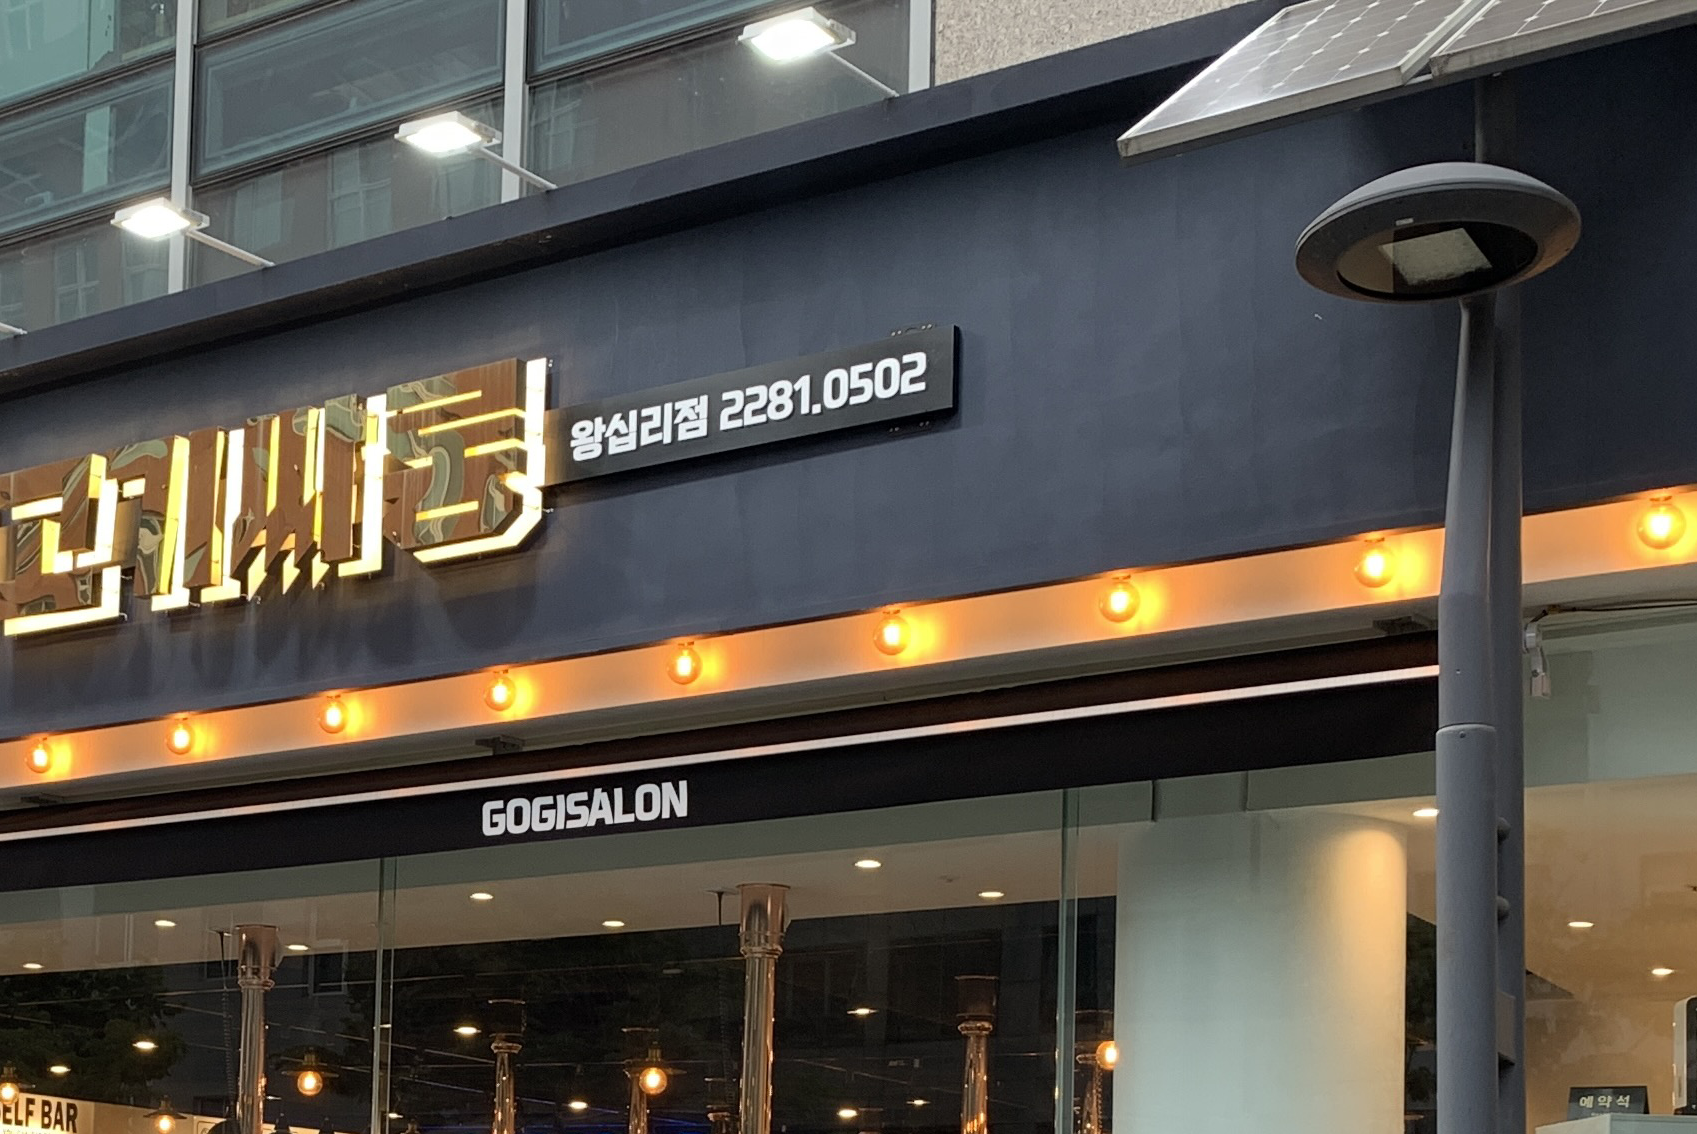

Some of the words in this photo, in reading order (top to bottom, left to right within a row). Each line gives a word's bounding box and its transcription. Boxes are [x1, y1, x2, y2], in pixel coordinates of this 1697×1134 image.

[569, 398, 708, 464] 왕십리점
[719, 351, 928, 432] 2281.0502
[482, 780, 689, 837] GOGISALON
[41, 1101, 78, 1134] BAR
